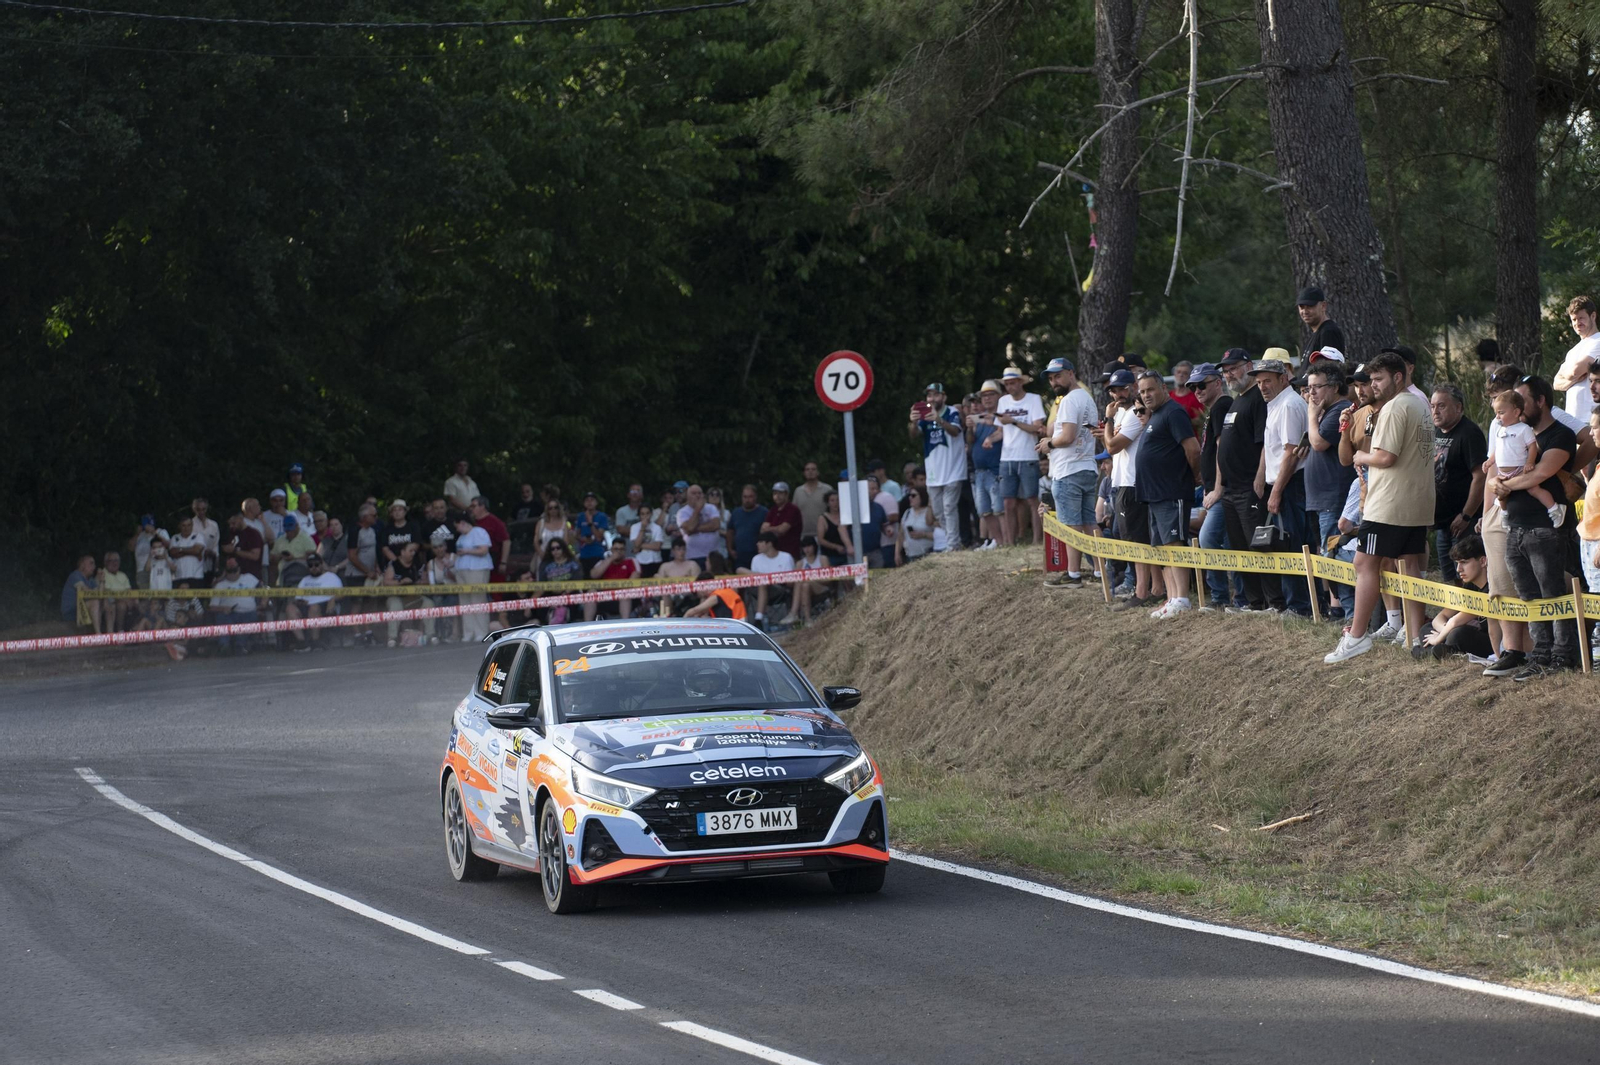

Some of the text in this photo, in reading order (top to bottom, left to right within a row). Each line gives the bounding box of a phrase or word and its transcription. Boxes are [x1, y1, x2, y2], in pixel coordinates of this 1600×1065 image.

[828, 371, 860, 392] 70
[1205, 553, 1218, 565] ZONA
[1217, 554, 1238, 567] PUBLICO
[1241, 555, 1255, 568] ZONA
[1254, 556, 1275, 569] PUBLICO
[1279, 557, 1293, 570] ZONA
[1316, 560, 1329, 575] ZONA
[1327, 562, 1344, 580] PUBLICO
[1412, 582, 1426, 597] ZONA
[1425, 585, 1446, 603] PUBLICO
[1449, 591, 1462, 606] ZONA
[1462, 594, 1484, 612] PUBLICO
[1487, 598, 1501, 614] ZONA
[1501, 601, 1529, 617] PUBLICO
[1540, 601, 1575, 617] ZONA
[214, 626, 228, 636] ZONA
[230, 623, 260, 634] PROHIBIDO
[262, 621, 287, 632] PUBLICO
[290, 619, 304, 630] ZONA
[306, 616, 337, 628] PROHIBIDO
[339, 614, 363, 626] PUBLICO
[366, 612, 380, 622] ZONA
[383, 610, 414, 621] PROHIBIDO
[416, 608, 440, 619] PUBLICO
[442, 606, 456, 616] ZONA
[460, 602, 490, 614] PROHIBIDO
[492, 601, 516, 612] PUBLICO
[520, 599, 534, 609] ZONA
[537, 596, 568, 607] PROHIBIDO
[570, 594, 594, 604] PUBLICO
[597, 592, 612, 602] ZONA
[615, 588, 646, 599] PROHIBIDO
[648, 586, 673, 597] PUBLICO
[675, 584, 690, 594] ZONA
[693, 580, 724, 592] PROHIBIDO
[726, 577, 751, 588] PUBLICO
[754, 576, 769, 585] ZONA
[772, 572, 802, 584] PROHIBIDO
[805, 569, 830, 580] PUBLICO
[832, 567, 848, 578] ZONA
[631, 637, 749, 649] HYUNDAI
[553, 656, 591, 676] 24
[652, 715, 766, 728] tabuenca
[642, 727, 703, 740] BRIVIO
[714, 732, 803, 741] Copa Hyundai
[749, 738, 787, 747] Rallye
[689, 763, 787, 784] cetelem
[857, 785, 877, 800] PIRELLI
[591, 803, 620, 816] PIRELLI
[710, 810, 793, 831] 3876 MMX
